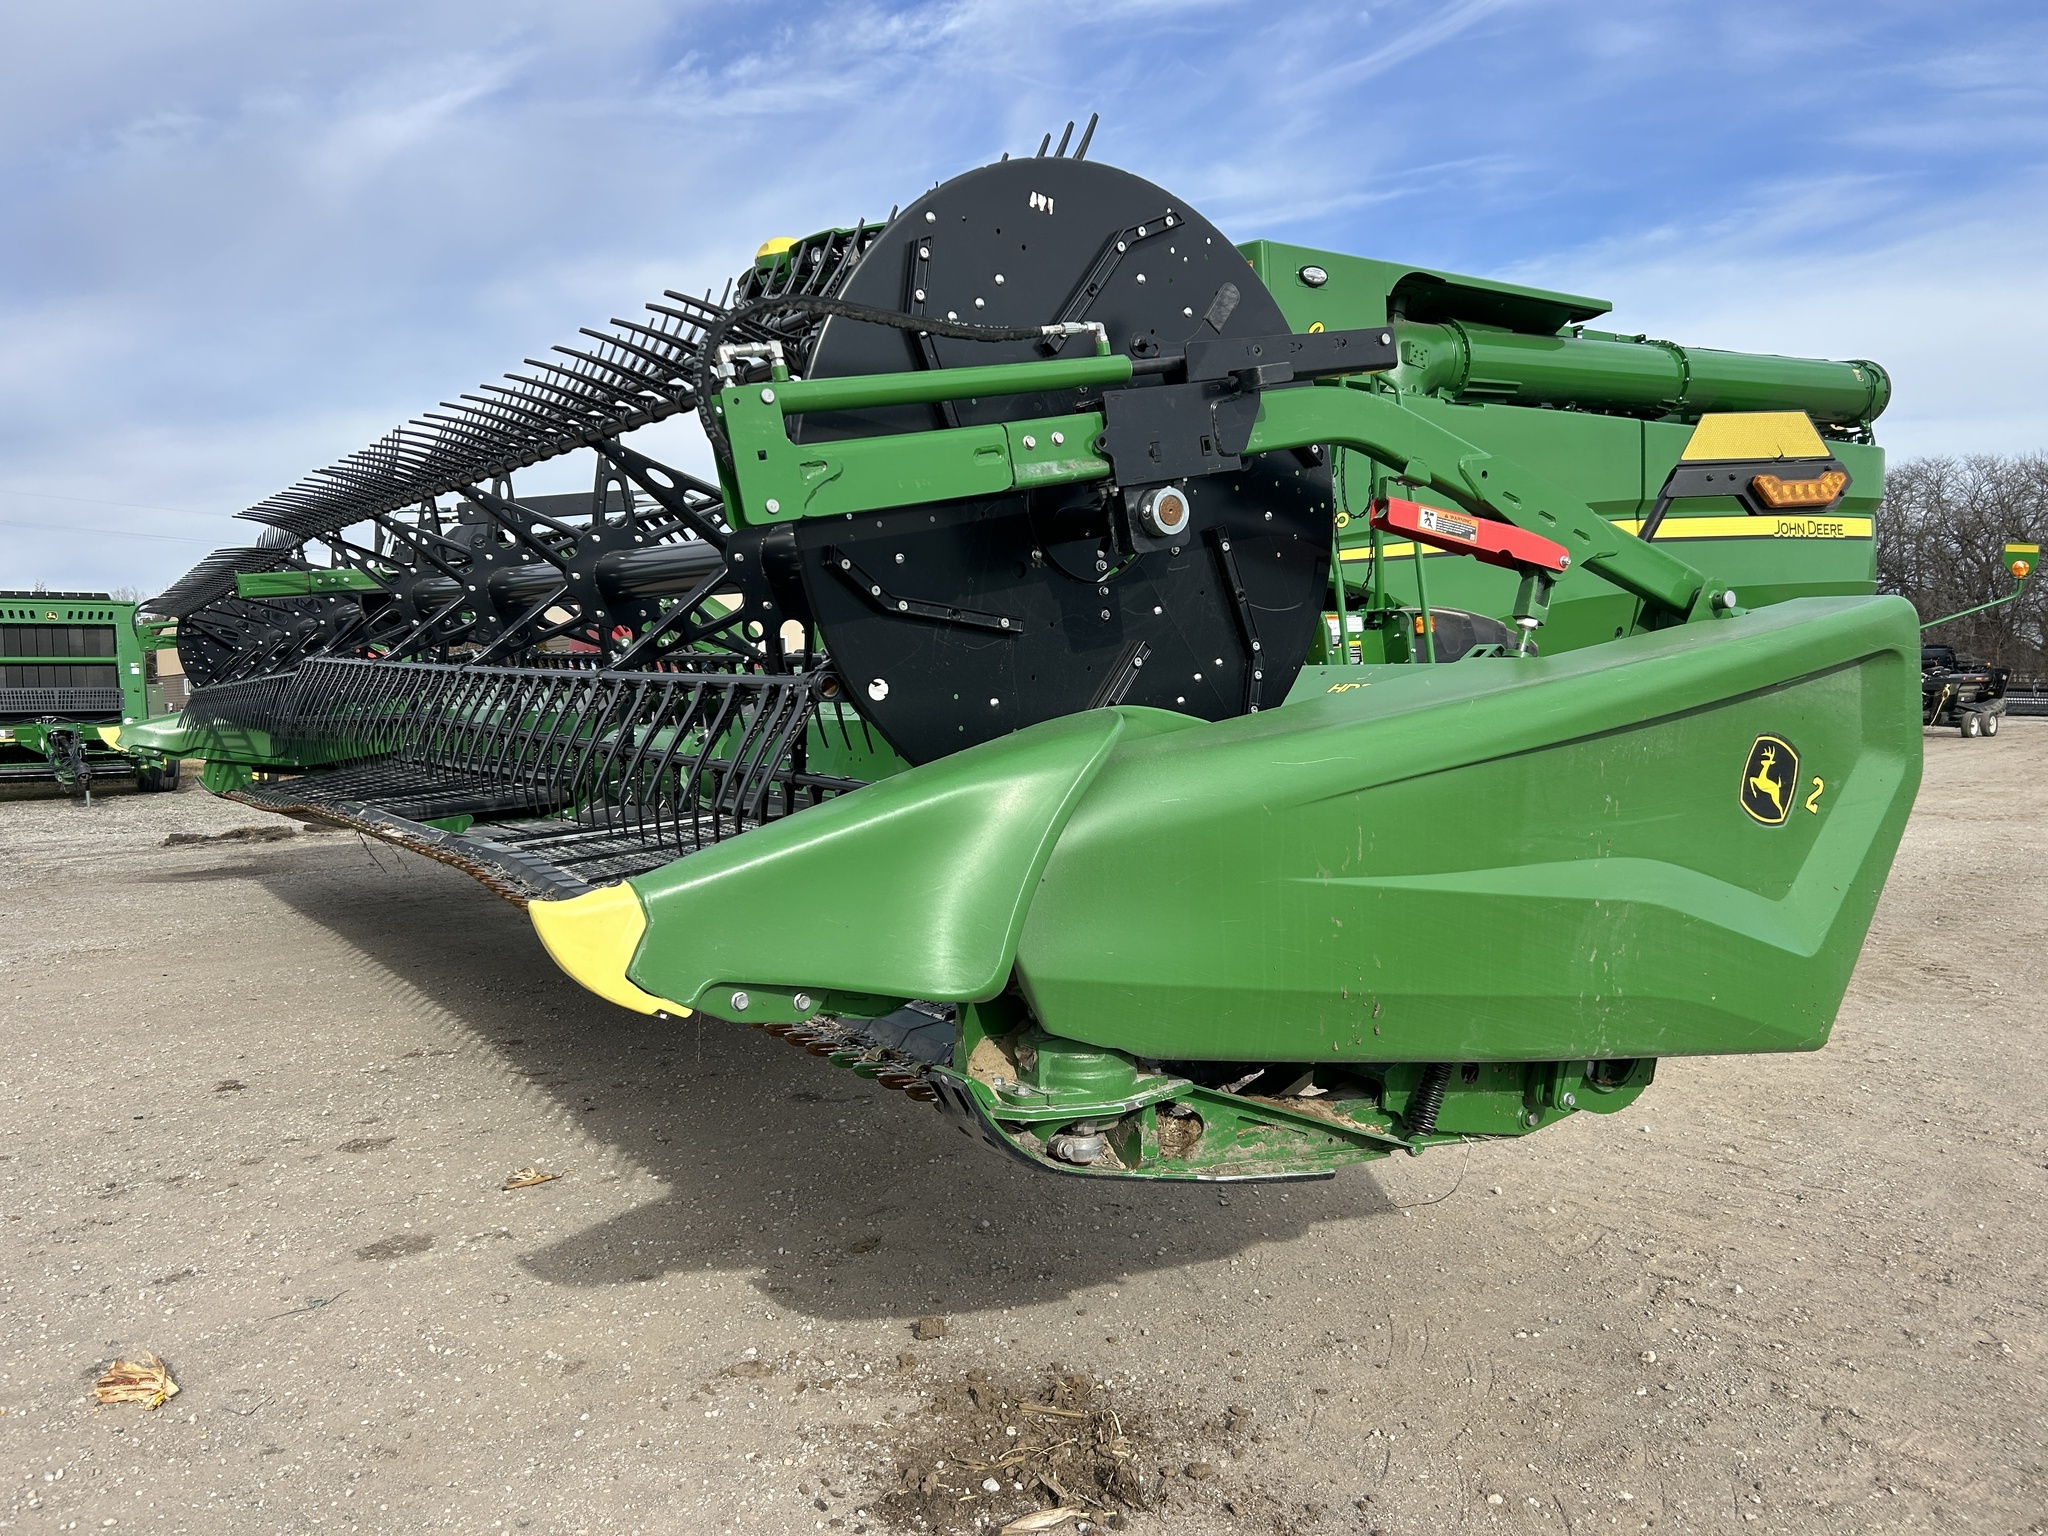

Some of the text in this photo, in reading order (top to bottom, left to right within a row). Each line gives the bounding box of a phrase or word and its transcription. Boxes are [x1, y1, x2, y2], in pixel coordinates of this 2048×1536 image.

[1449, 515, 1472, 525] WARNING
[1773, 519, 1844, 536] JOHN DEERE
[1804, 774, 1825, 815] 2
